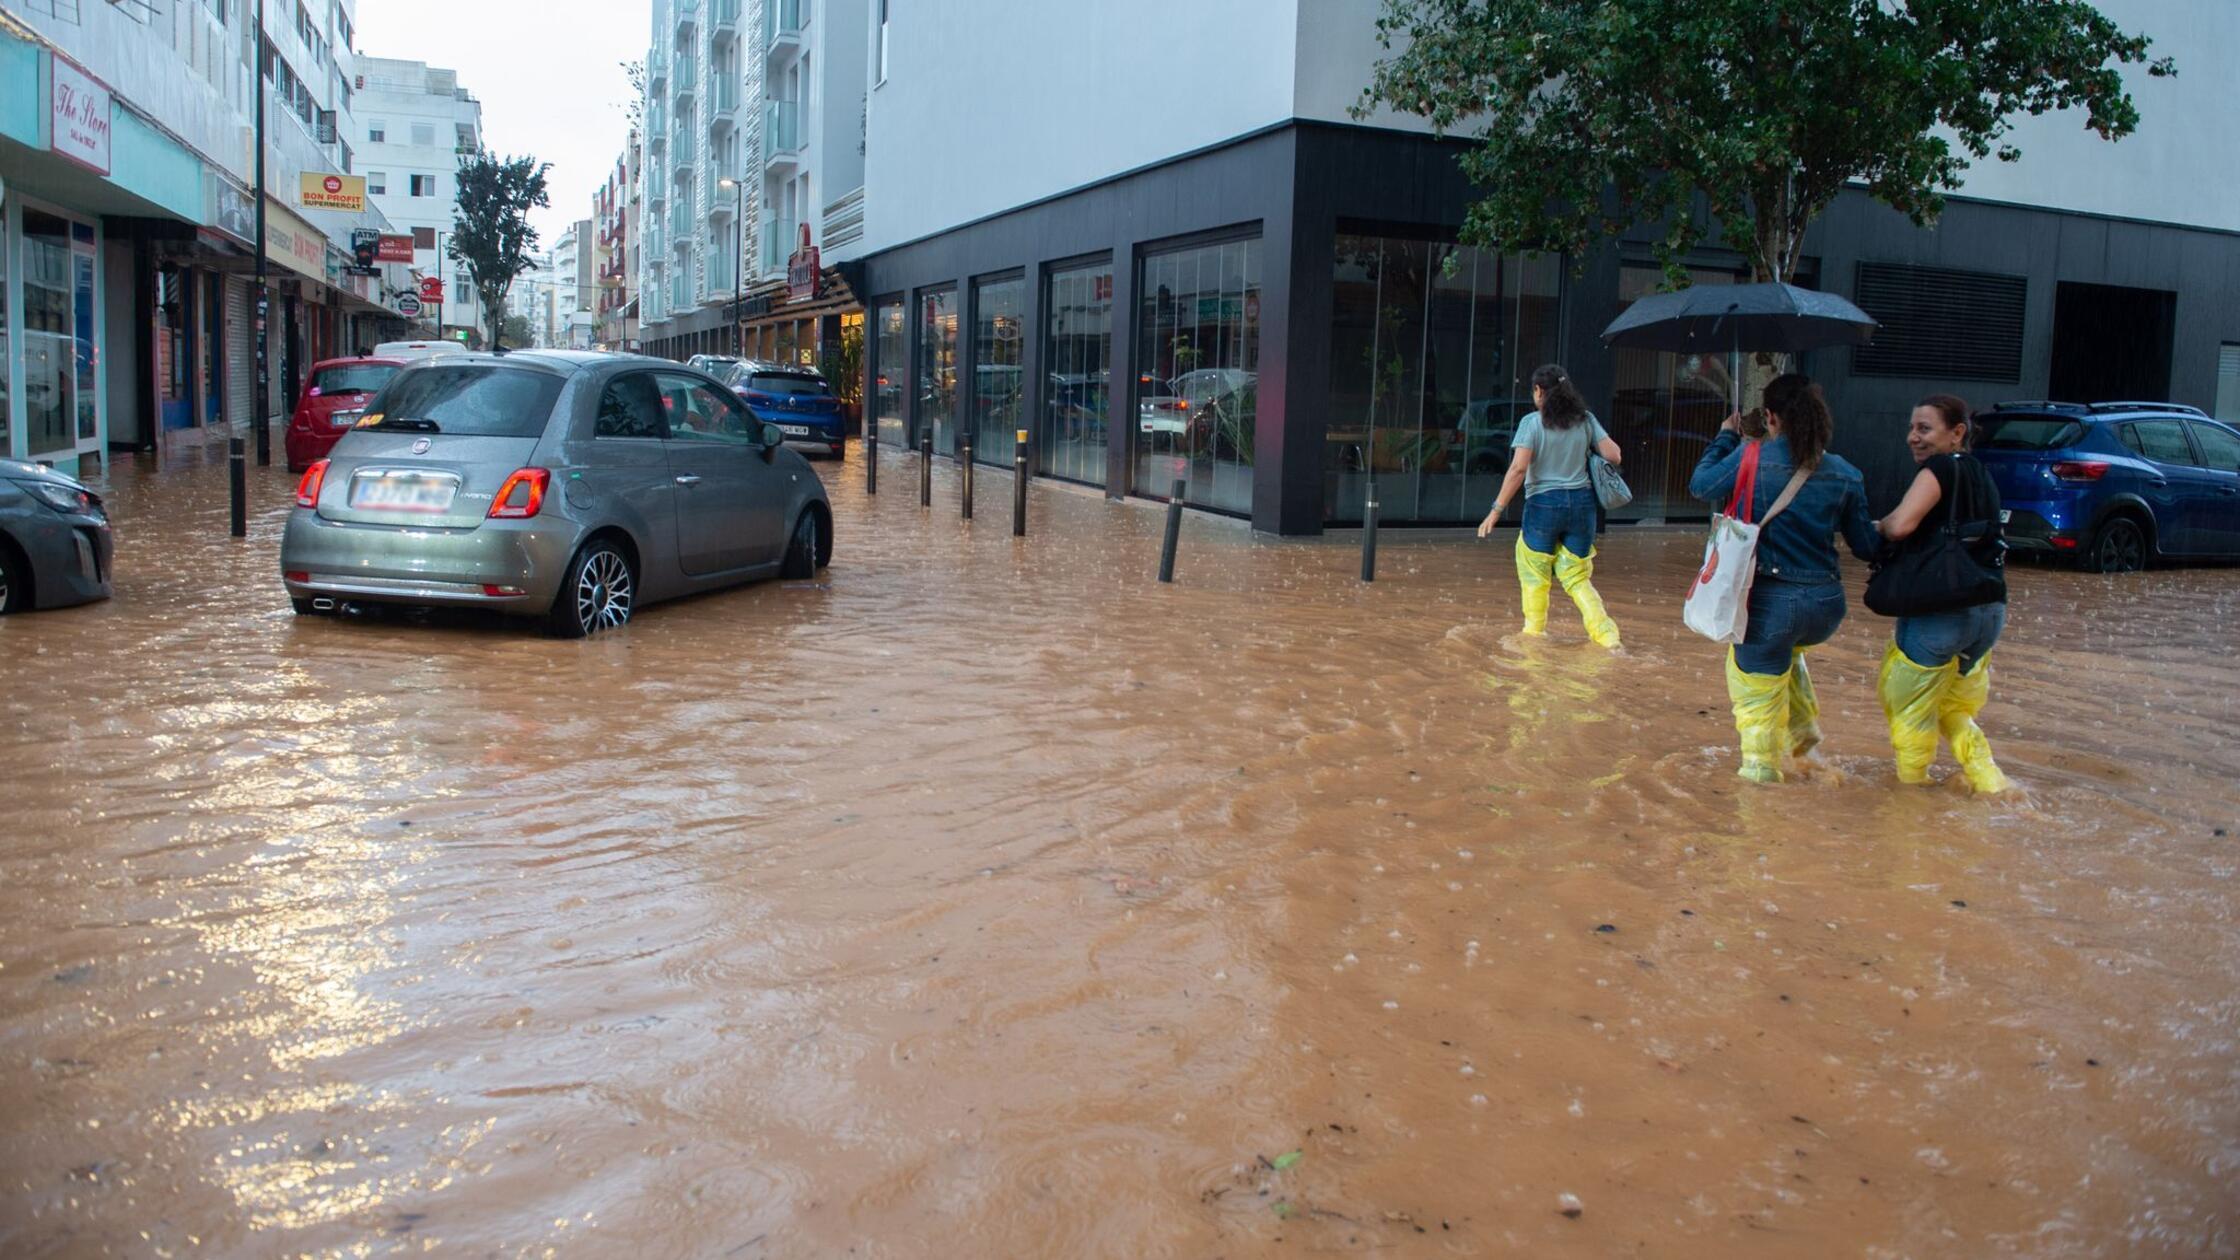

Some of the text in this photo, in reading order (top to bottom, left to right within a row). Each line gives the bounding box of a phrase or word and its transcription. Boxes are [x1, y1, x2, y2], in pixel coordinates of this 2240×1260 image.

[56, 83, 107, 135] The Store
[303, 192, 324, 200] BON
[303, 200, 361, 209] SUPERMERCAT
[357, 231, 378, 240] ATM
